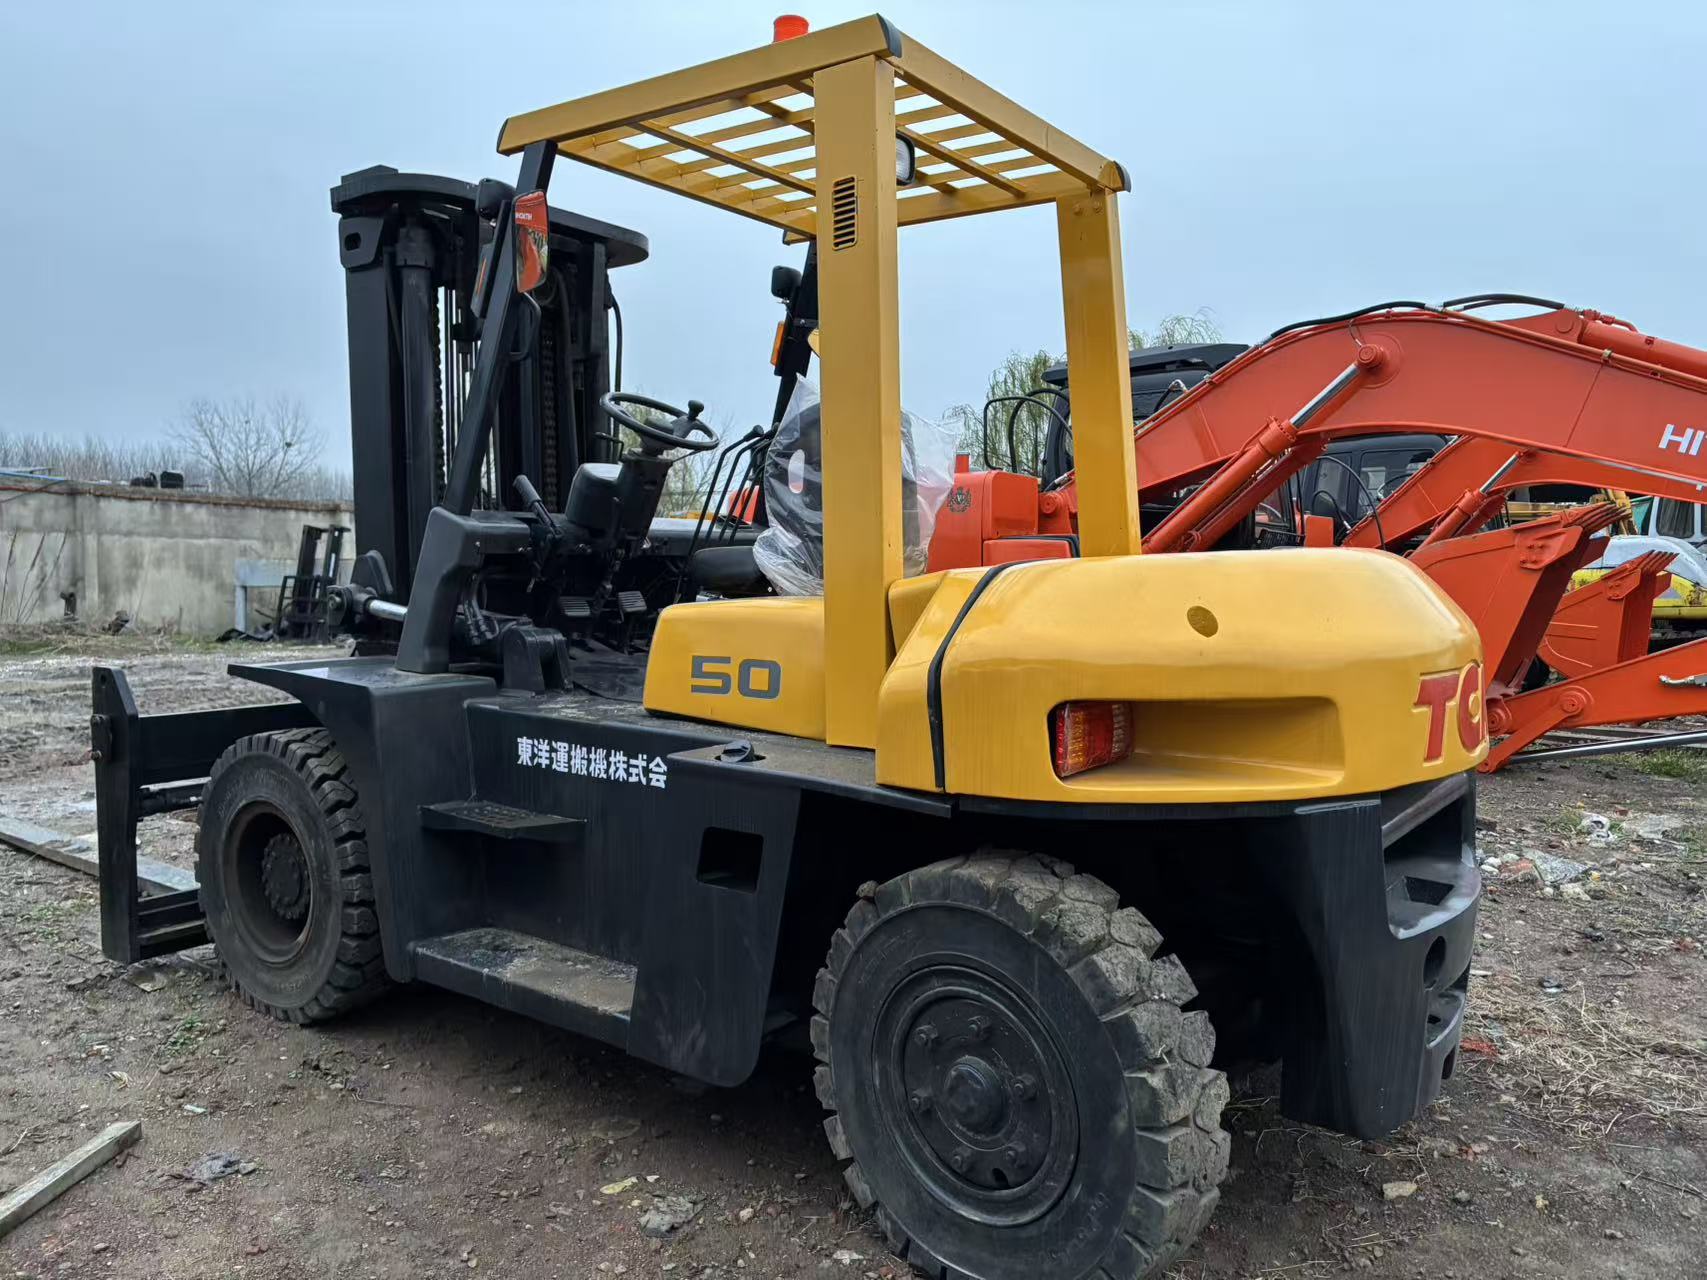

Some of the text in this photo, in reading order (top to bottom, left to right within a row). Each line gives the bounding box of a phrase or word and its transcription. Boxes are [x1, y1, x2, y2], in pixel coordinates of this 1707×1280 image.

[1658, 423, 1707, 455] HI
[690, 655, 781, 700] 50
[1411, 660, 1487, 766] TC
[517, 736, 668, 789] 東洋運搬機株式会
